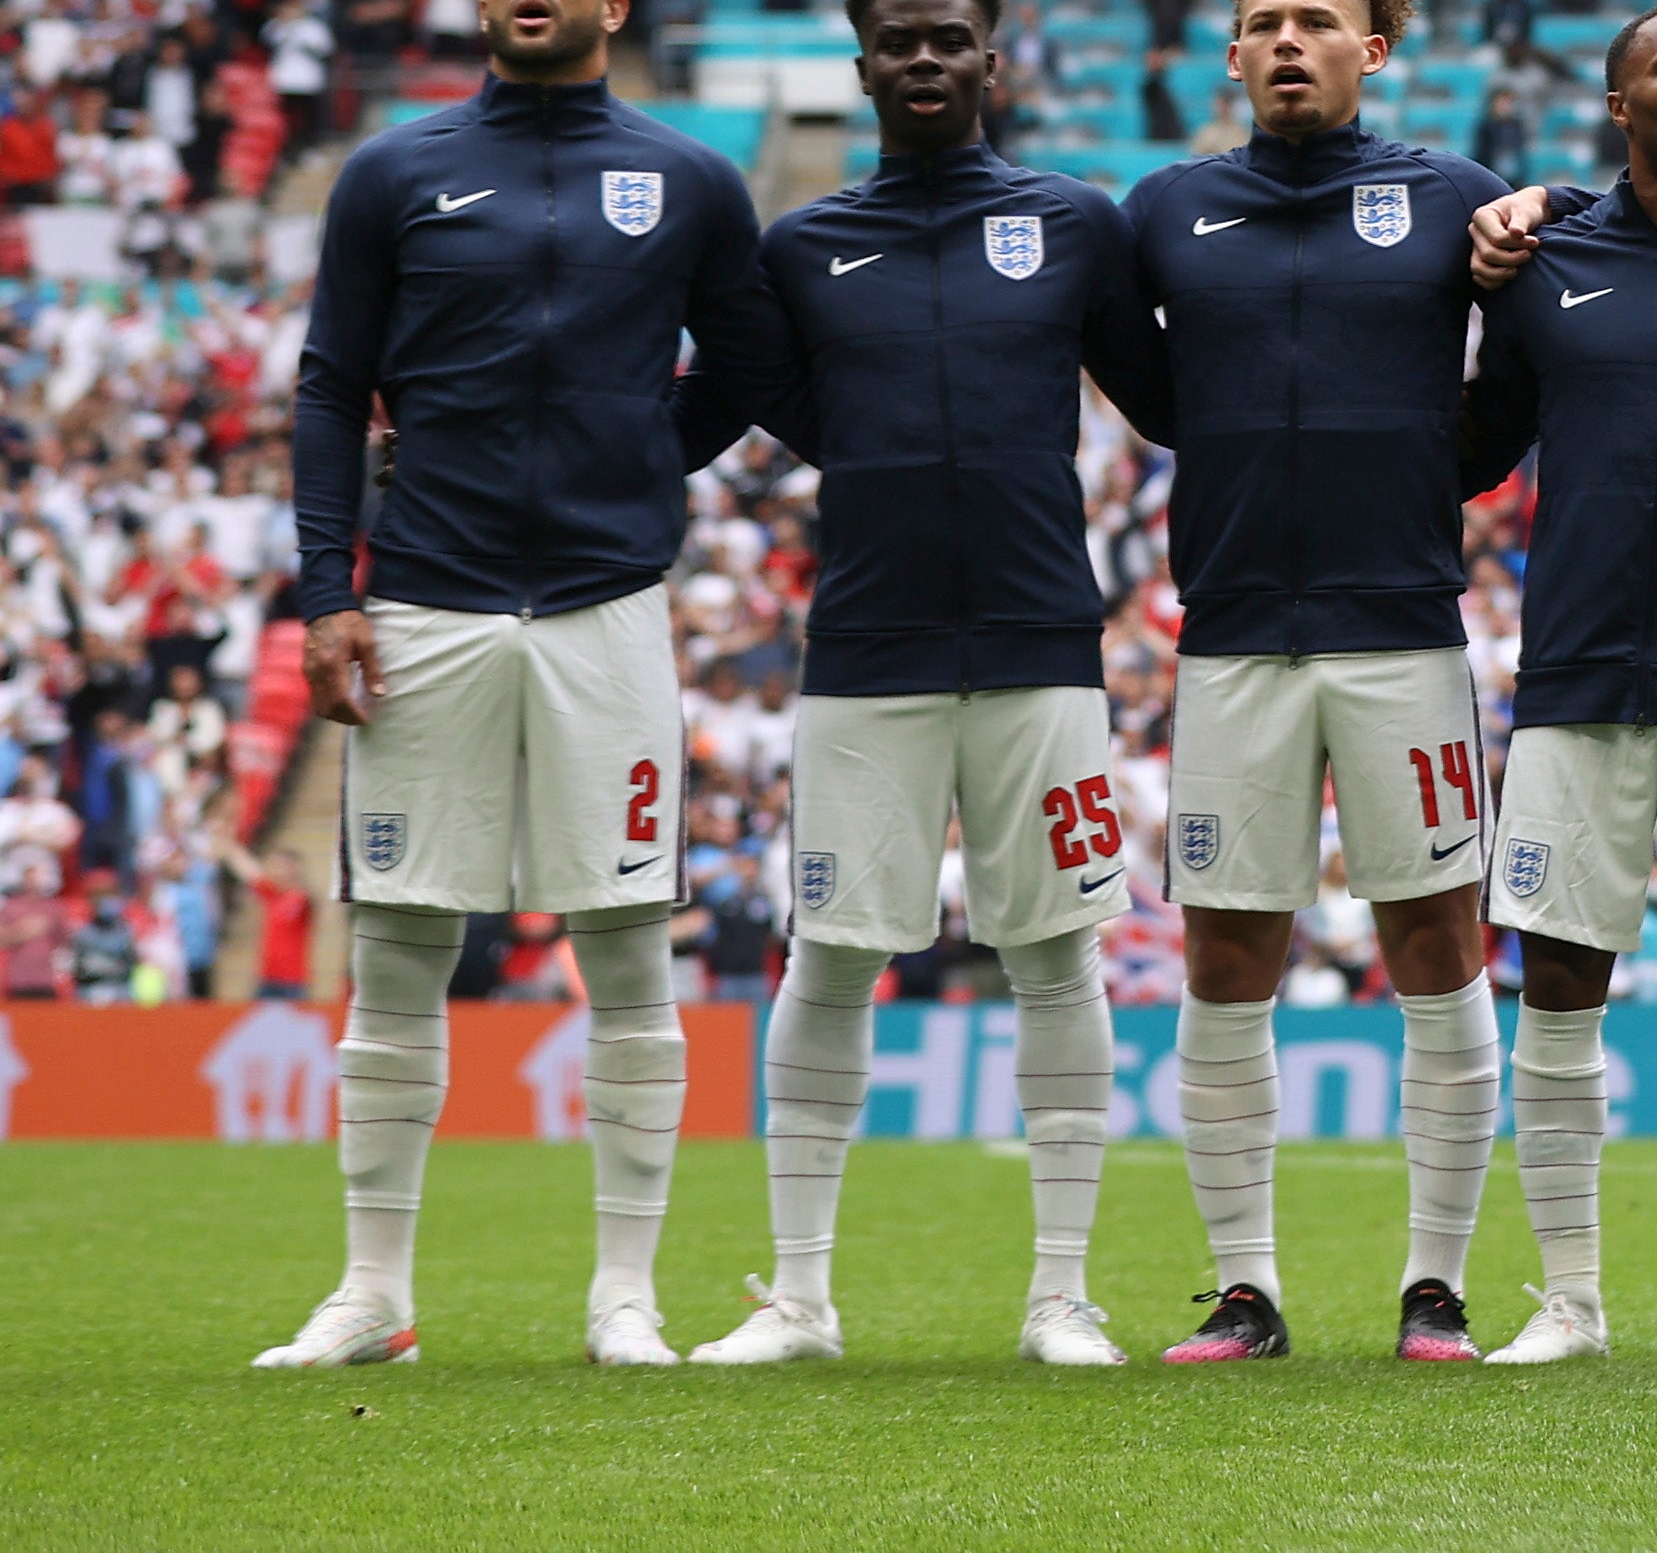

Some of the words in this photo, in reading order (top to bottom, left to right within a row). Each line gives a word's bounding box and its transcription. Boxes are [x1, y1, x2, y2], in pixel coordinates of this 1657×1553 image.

[626, 758, 659, 843] 2
[1041, 774, 1123, 872] 25
[1408, 741, 1479, 829] 14
